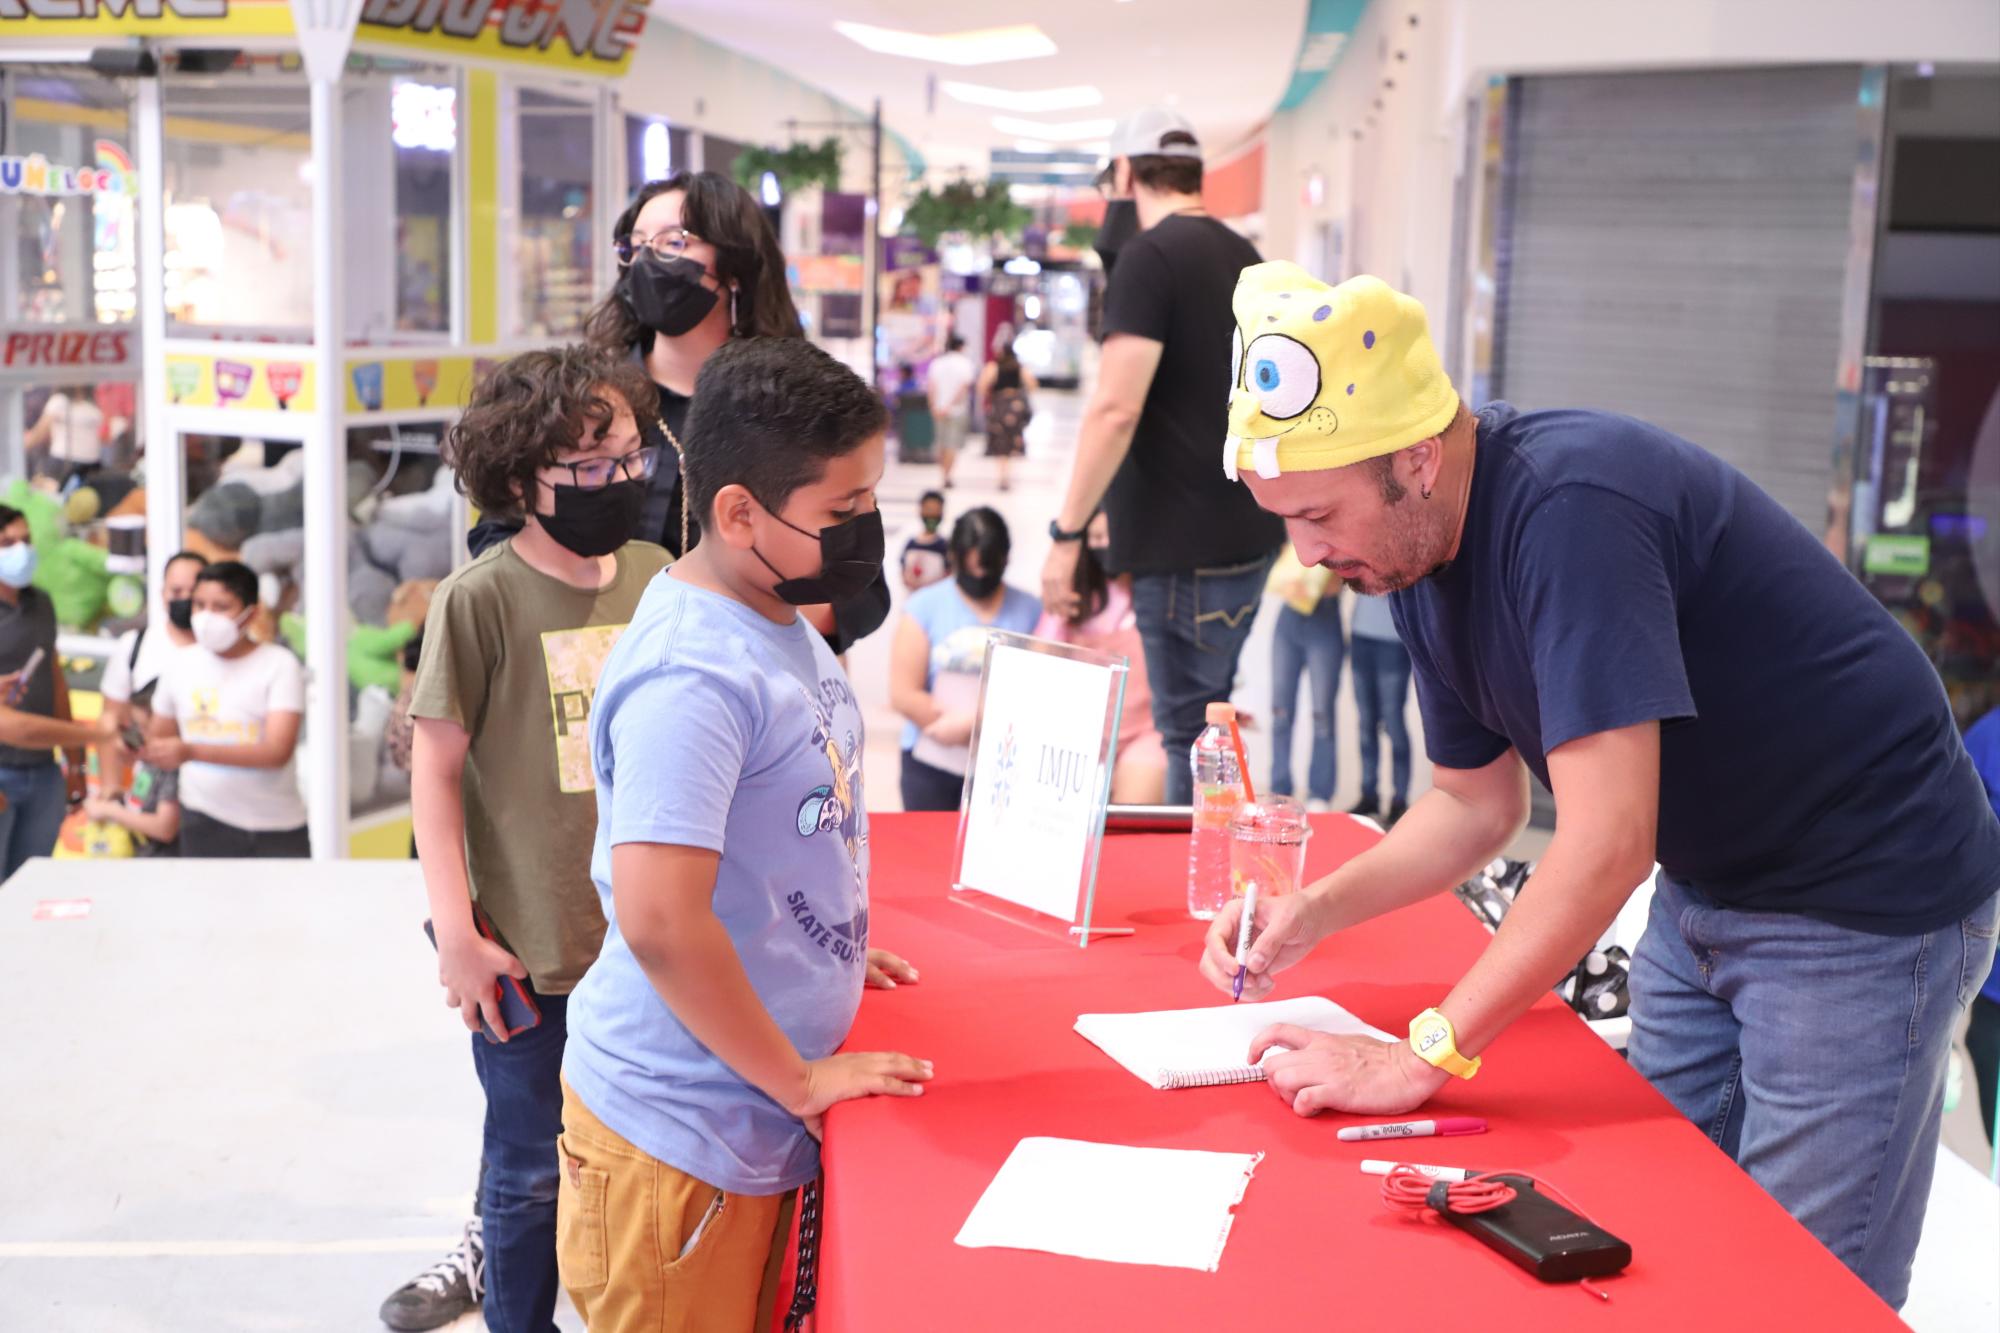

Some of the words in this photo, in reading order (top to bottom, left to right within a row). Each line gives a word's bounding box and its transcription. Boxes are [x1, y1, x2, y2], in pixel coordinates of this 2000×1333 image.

[4, 331, 129, 366] PRIZES
[1037, 744, 1088, 801] IMJU
[786, 890, 832, 948] SKATE
